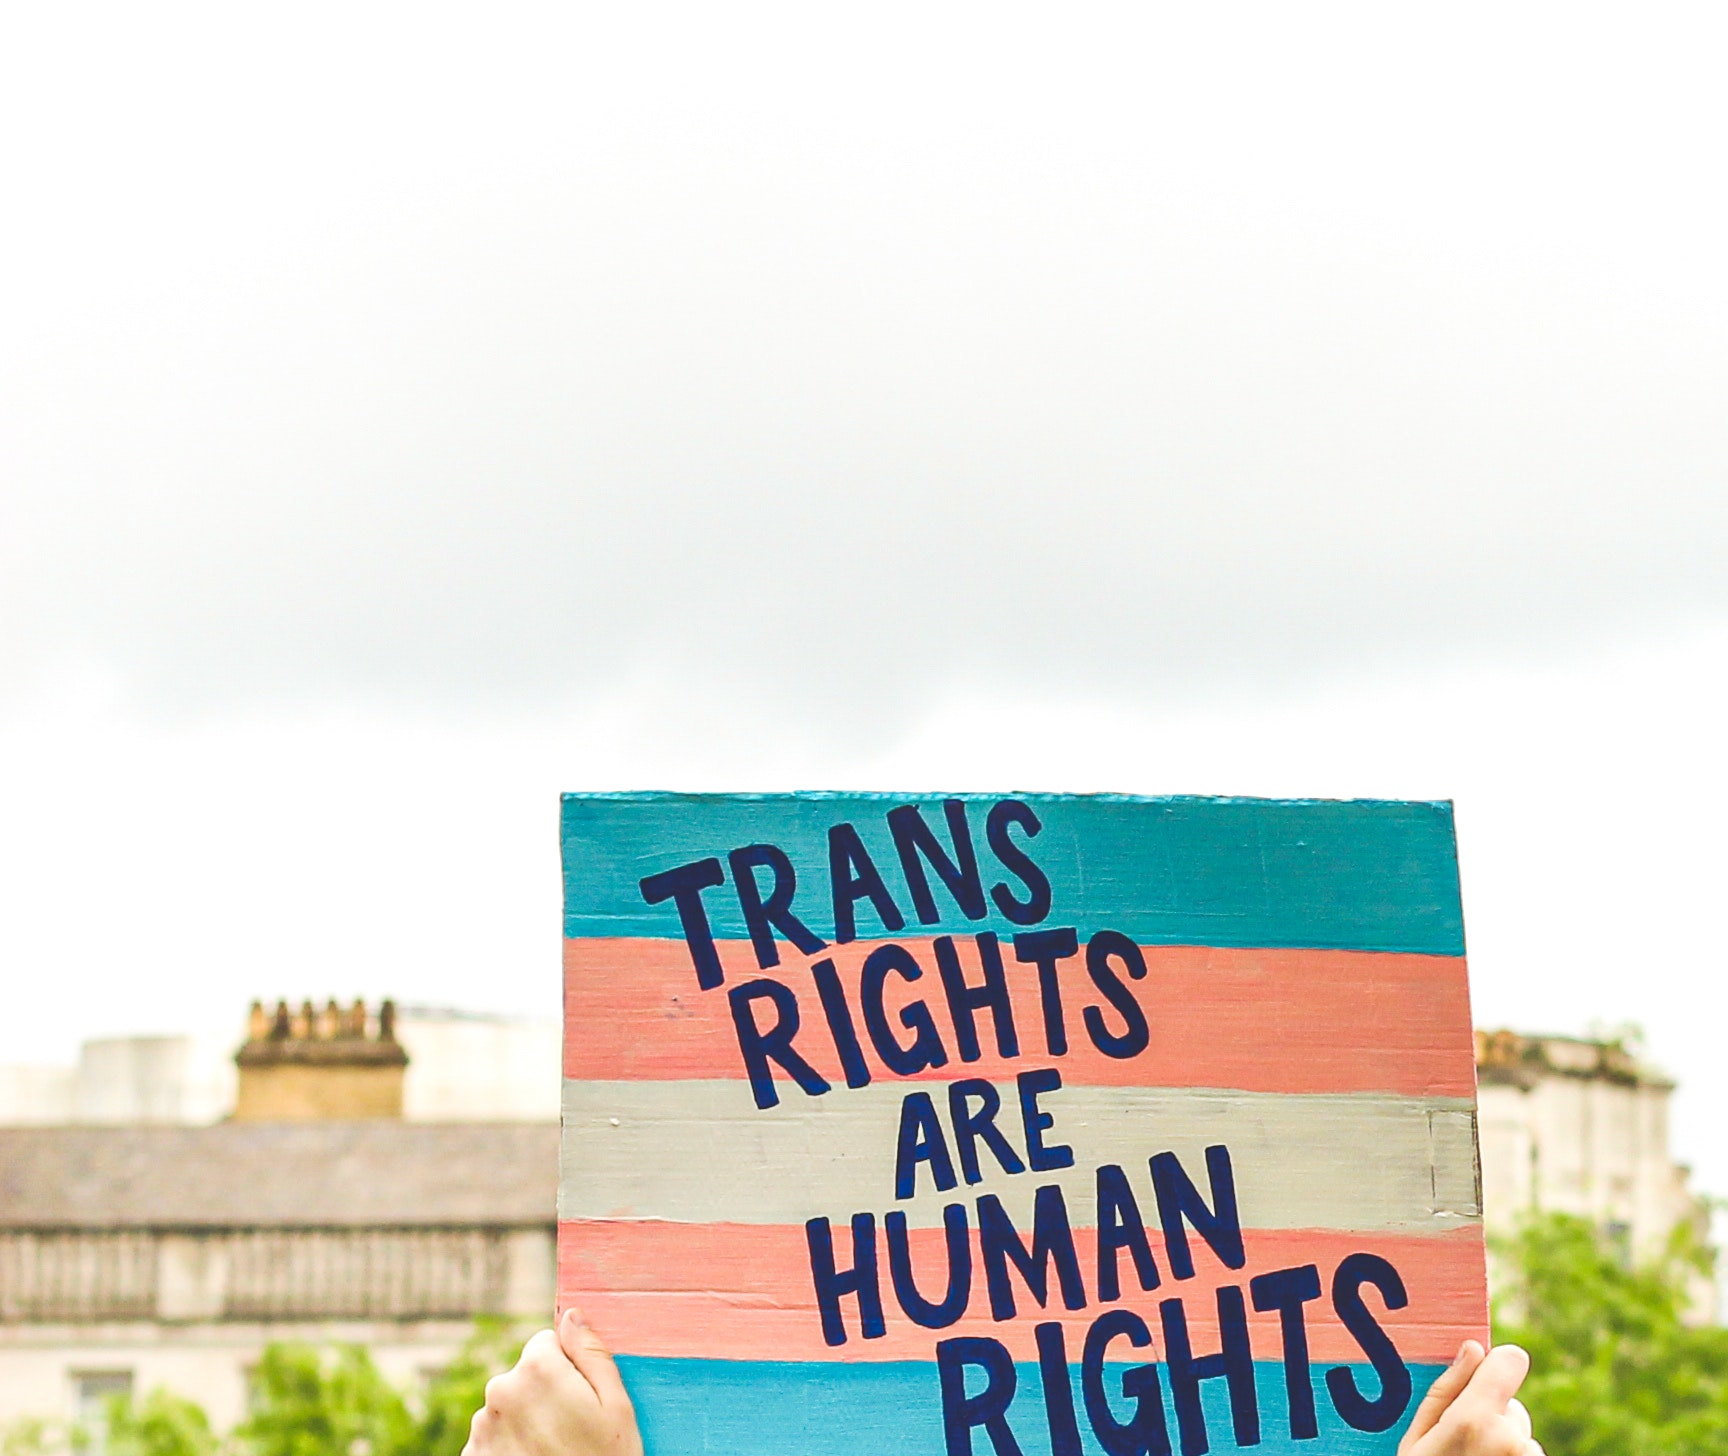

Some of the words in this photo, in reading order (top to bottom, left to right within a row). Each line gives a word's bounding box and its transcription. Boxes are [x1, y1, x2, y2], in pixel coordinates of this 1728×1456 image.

[640, 800, 1050, 989] TRANS
[730, 928, 1148, 1109] RIGHTS
[896, 1070, 1073, 1199] ARE
[807, 1145, 1244, 1345] HUMAN
